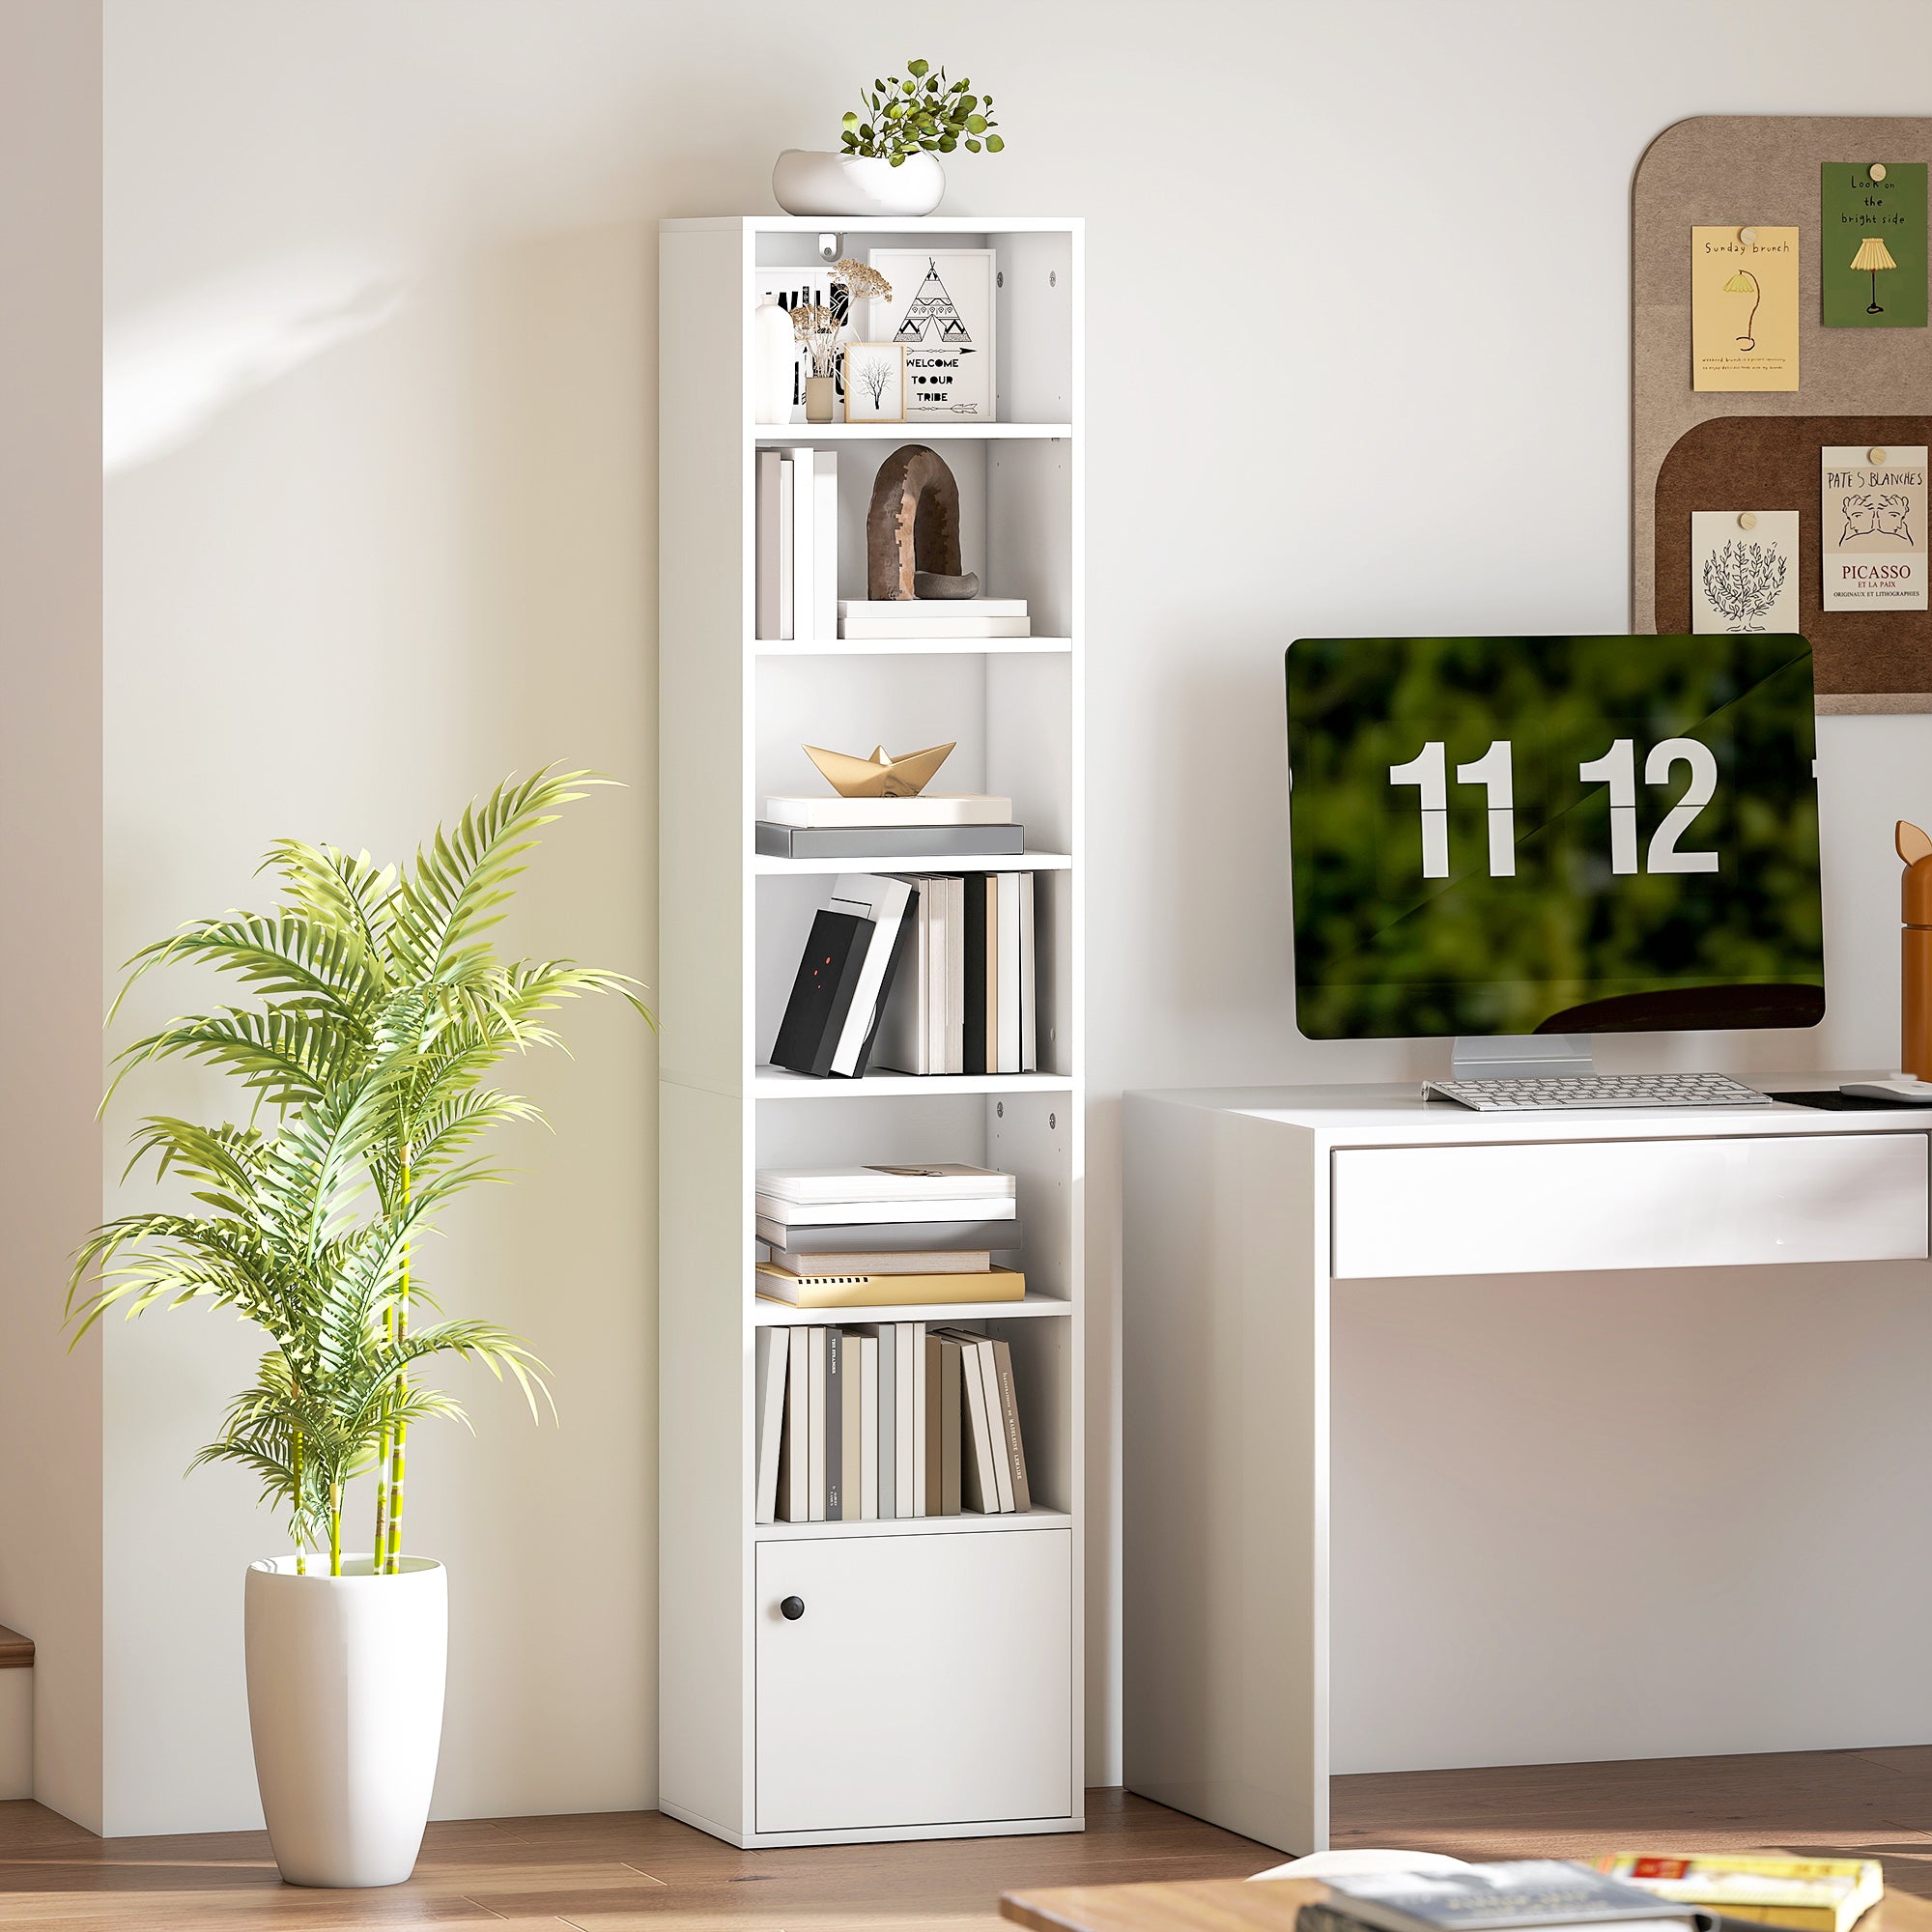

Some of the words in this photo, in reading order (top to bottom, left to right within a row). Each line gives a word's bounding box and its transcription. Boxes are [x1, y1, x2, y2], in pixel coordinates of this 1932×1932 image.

[1851, 175, 1879, 188] Look
[1863, 195, 1883, 207] the
[1841, 212, 1877, 226] bright
[1882, 213, 1905, 224] side
[1705, 242, 1746, 255] Sunday
[1752, 241, 1790, 253] brunch
[906, 358, 959, 368] WELCOME
[911, 376, 926, 384] TO
[929, 376, 952, 384] OUR
[917, 392, 949, 402] TRIBE
[1868, 471, 1923, 487] BLANCHES
[1842, 565, 1911, 580] PICASSO
[1389, 740, 1516, 878] 11
[1578, 737, 1719, 875] 12
